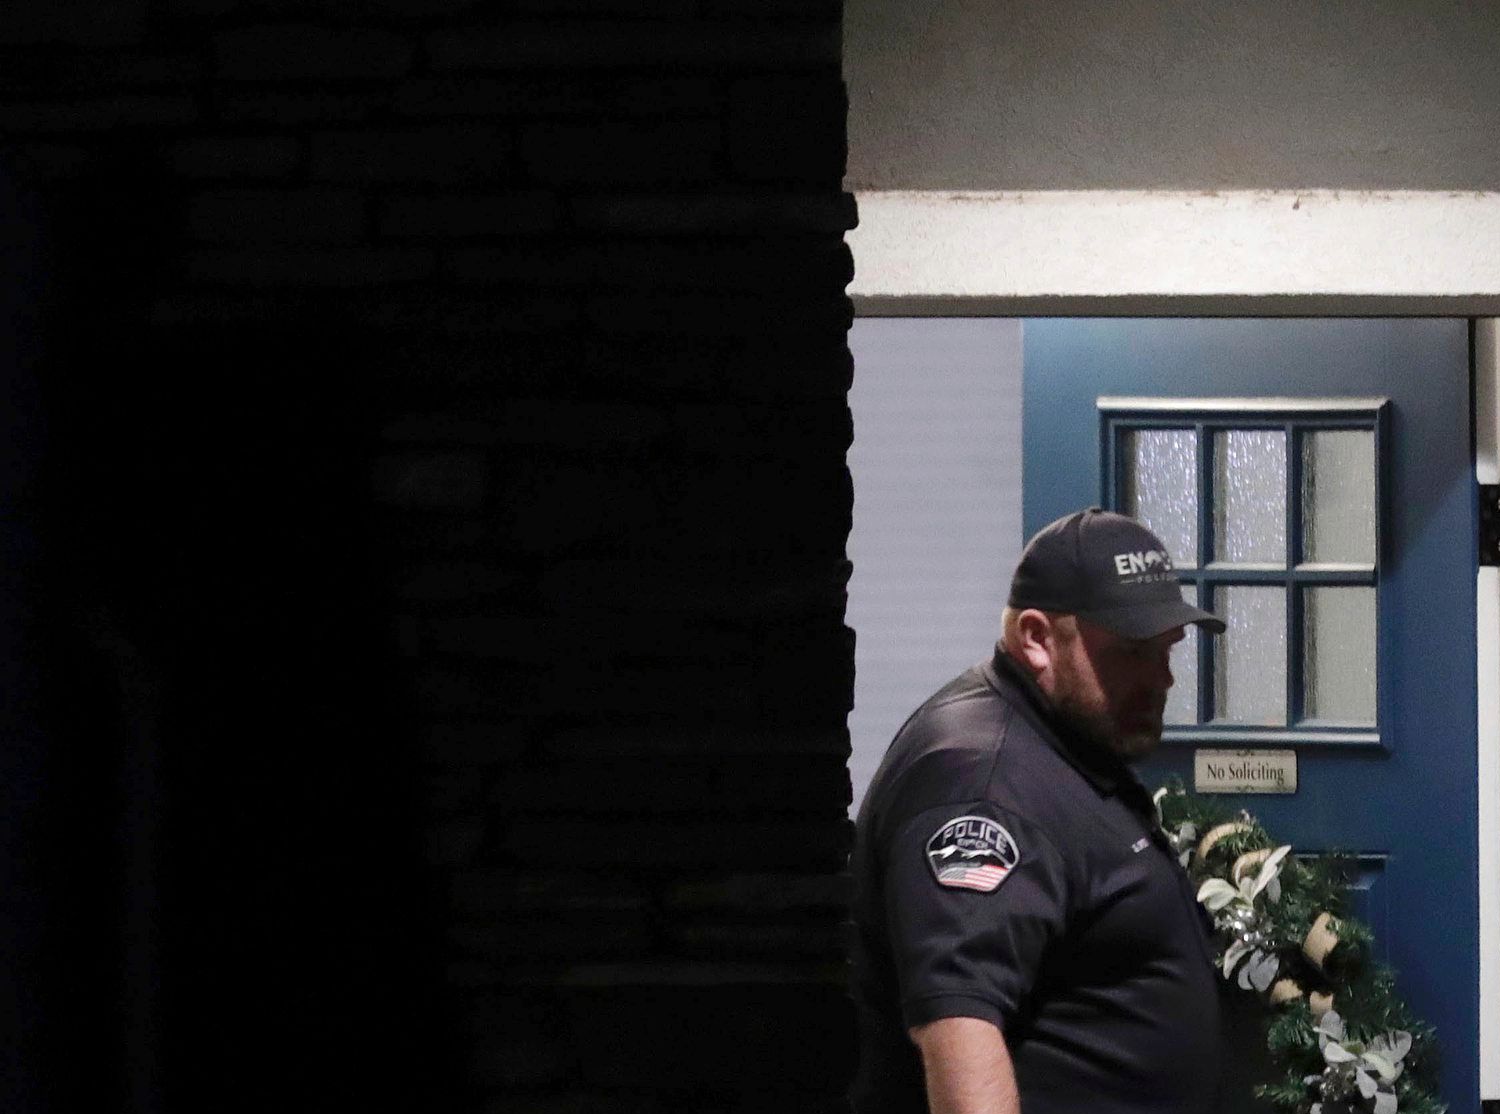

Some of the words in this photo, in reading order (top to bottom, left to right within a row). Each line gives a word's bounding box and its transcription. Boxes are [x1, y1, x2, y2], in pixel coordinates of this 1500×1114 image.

[1207, 764, 1225, 780] No
[1228, 762, 1284, 785] Soliciting
[941, 821, 1007, 855] POLICE
